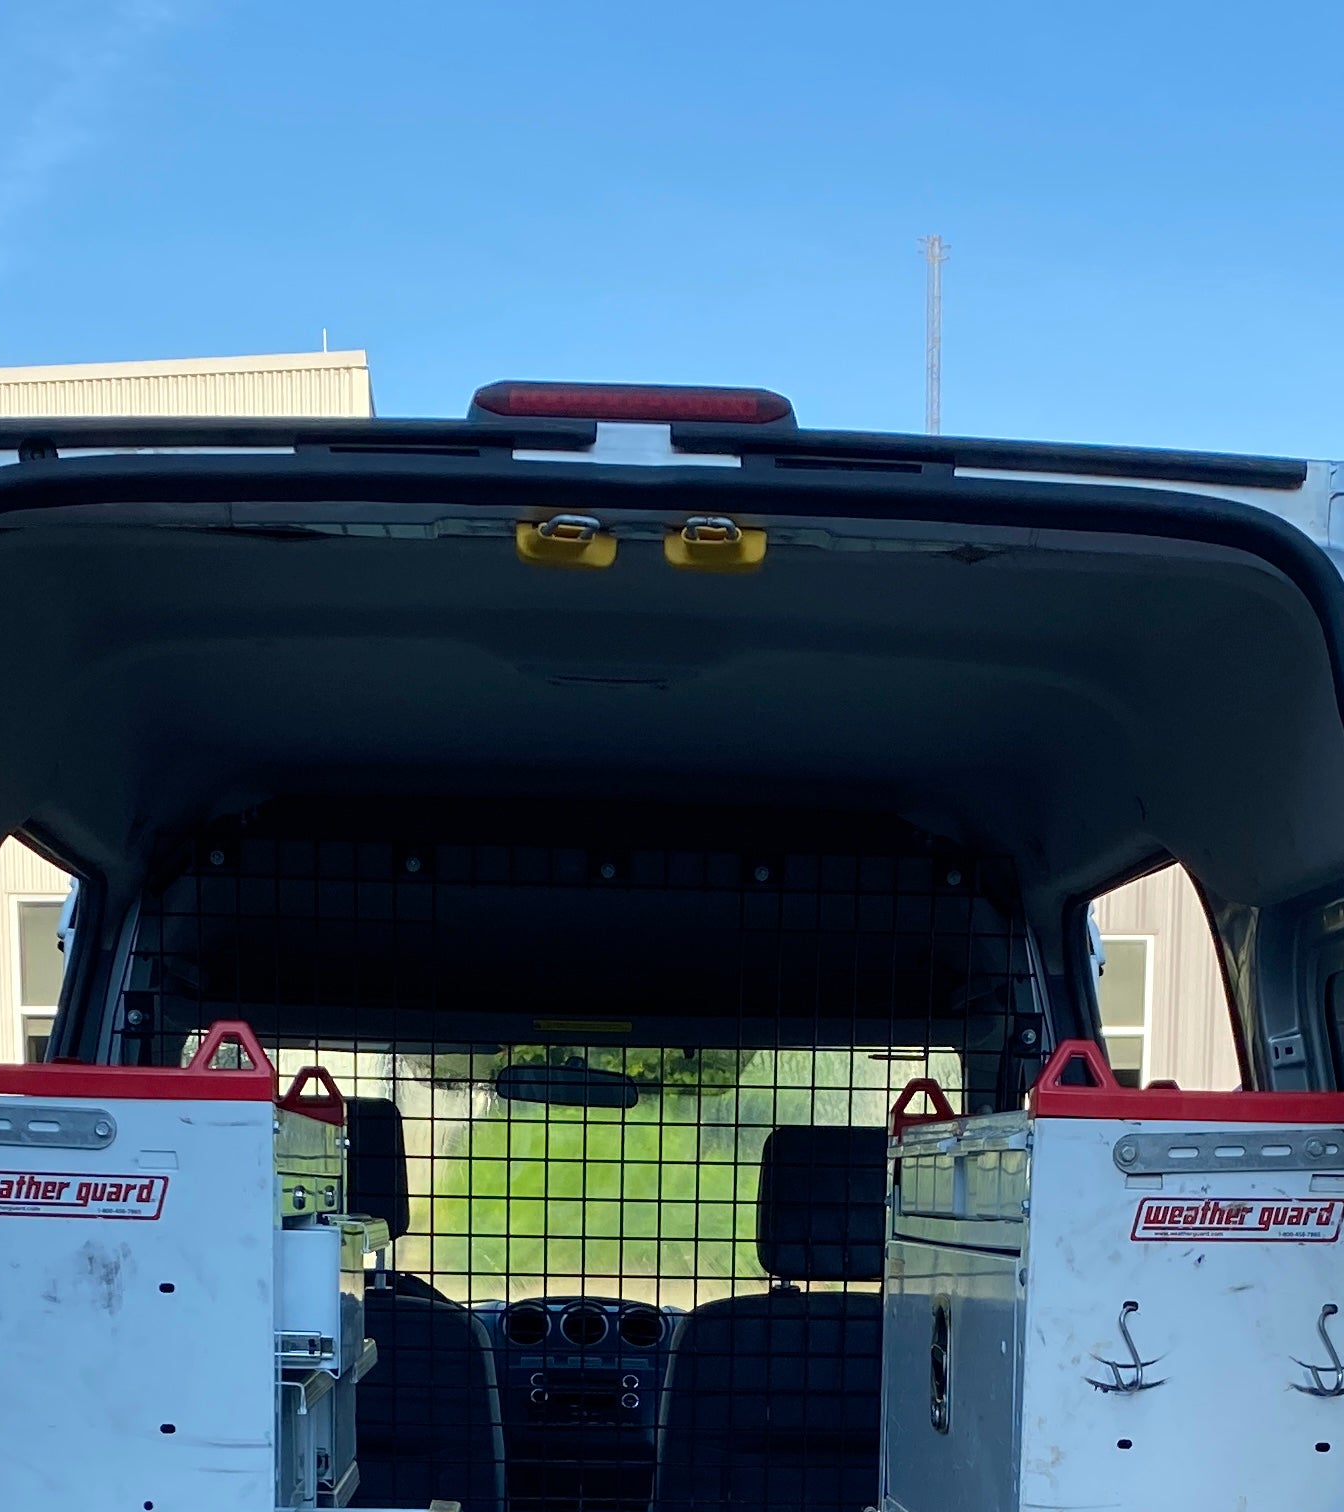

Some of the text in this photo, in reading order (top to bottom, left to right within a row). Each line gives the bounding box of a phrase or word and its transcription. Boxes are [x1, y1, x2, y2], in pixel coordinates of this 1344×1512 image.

[76, 1180, 155, 1207] guard
[1144, 1201, 1335, 1231] weather guard
